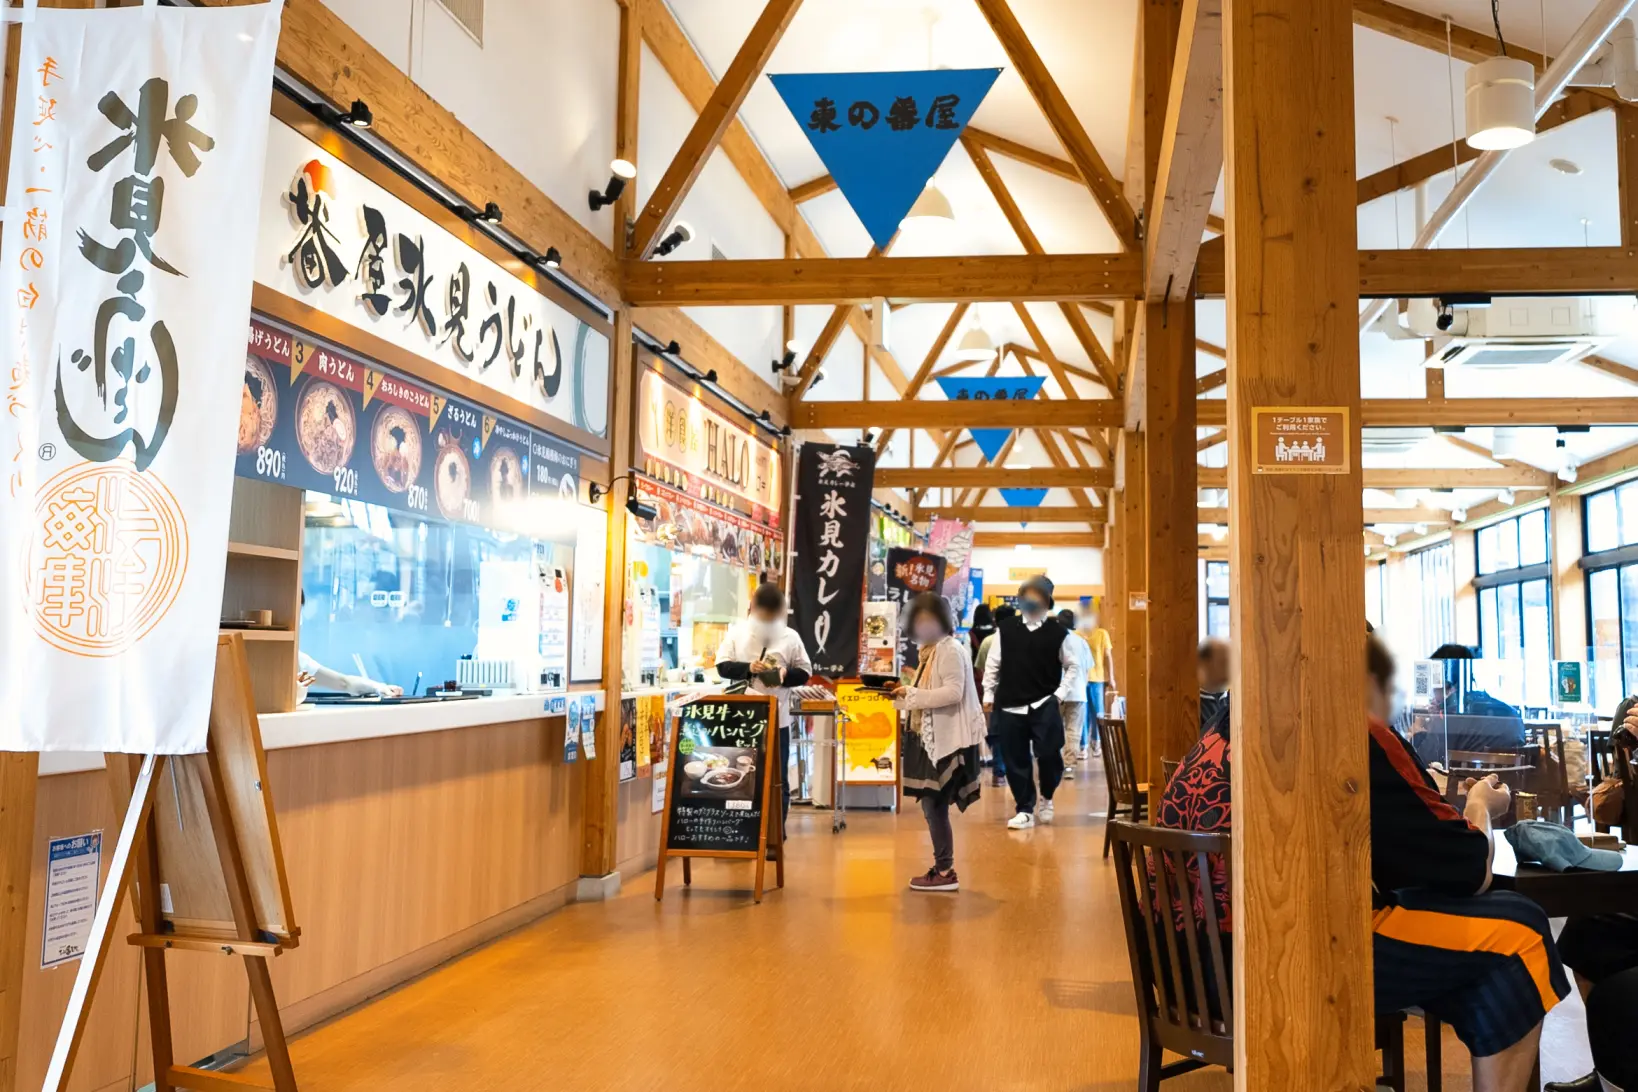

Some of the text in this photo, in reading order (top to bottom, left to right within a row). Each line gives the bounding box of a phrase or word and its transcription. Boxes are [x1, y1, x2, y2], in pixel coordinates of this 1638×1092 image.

[807, 93, 961, 133] 東の番屋
[295, 341, 304, 364] 3
[318, 352, 355, 382] 肉うどん
[366, 371, 374, 390] 4
[433, 397, 440, 415] 5
[484, 416, 490, 434] 6
[1272, 416, 1328, 424] 1テーブル1家族で
[256, 446, 281, 478] 890
[703, 419, 750, 488] HALO
[333, 466, 354, 494] 920
[537, 464, 548, 484] 180
[407, 484, 425, 511] 870
[685, 704, 755, 721] 氷見牛入り
